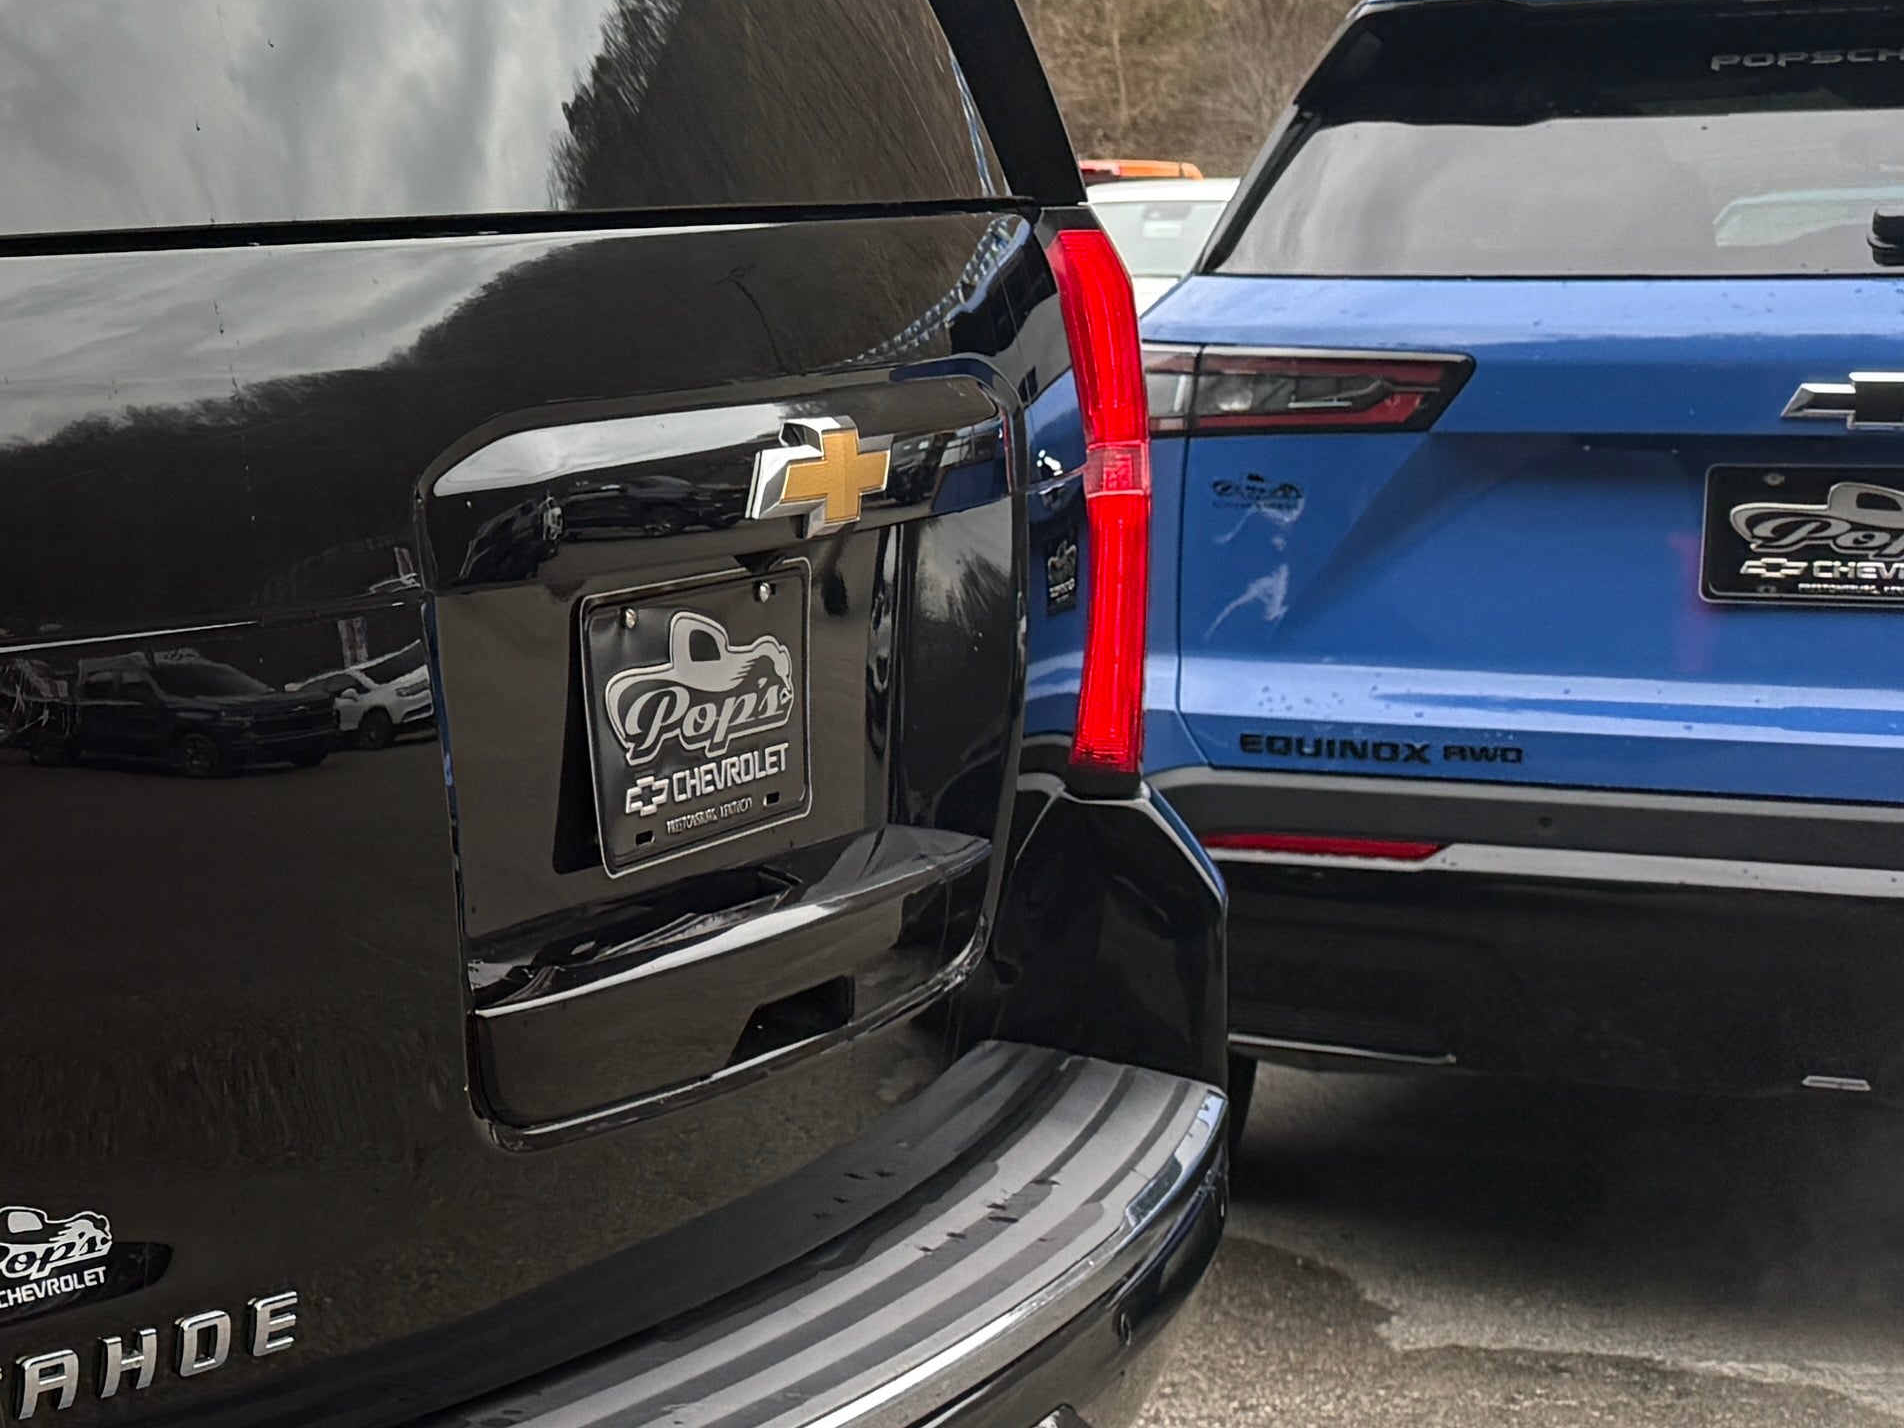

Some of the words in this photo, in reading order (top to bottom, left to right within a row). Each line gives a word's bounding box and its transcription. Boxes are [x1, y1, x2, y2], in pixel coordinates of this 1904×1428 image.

[1812, 560, 1904, 580] CHEV
[623, 676, 785, 752] Pop's
[1239, 732, 1431, 764] EQUINOX
[672, 742, 789, 803] CHEVROLET
